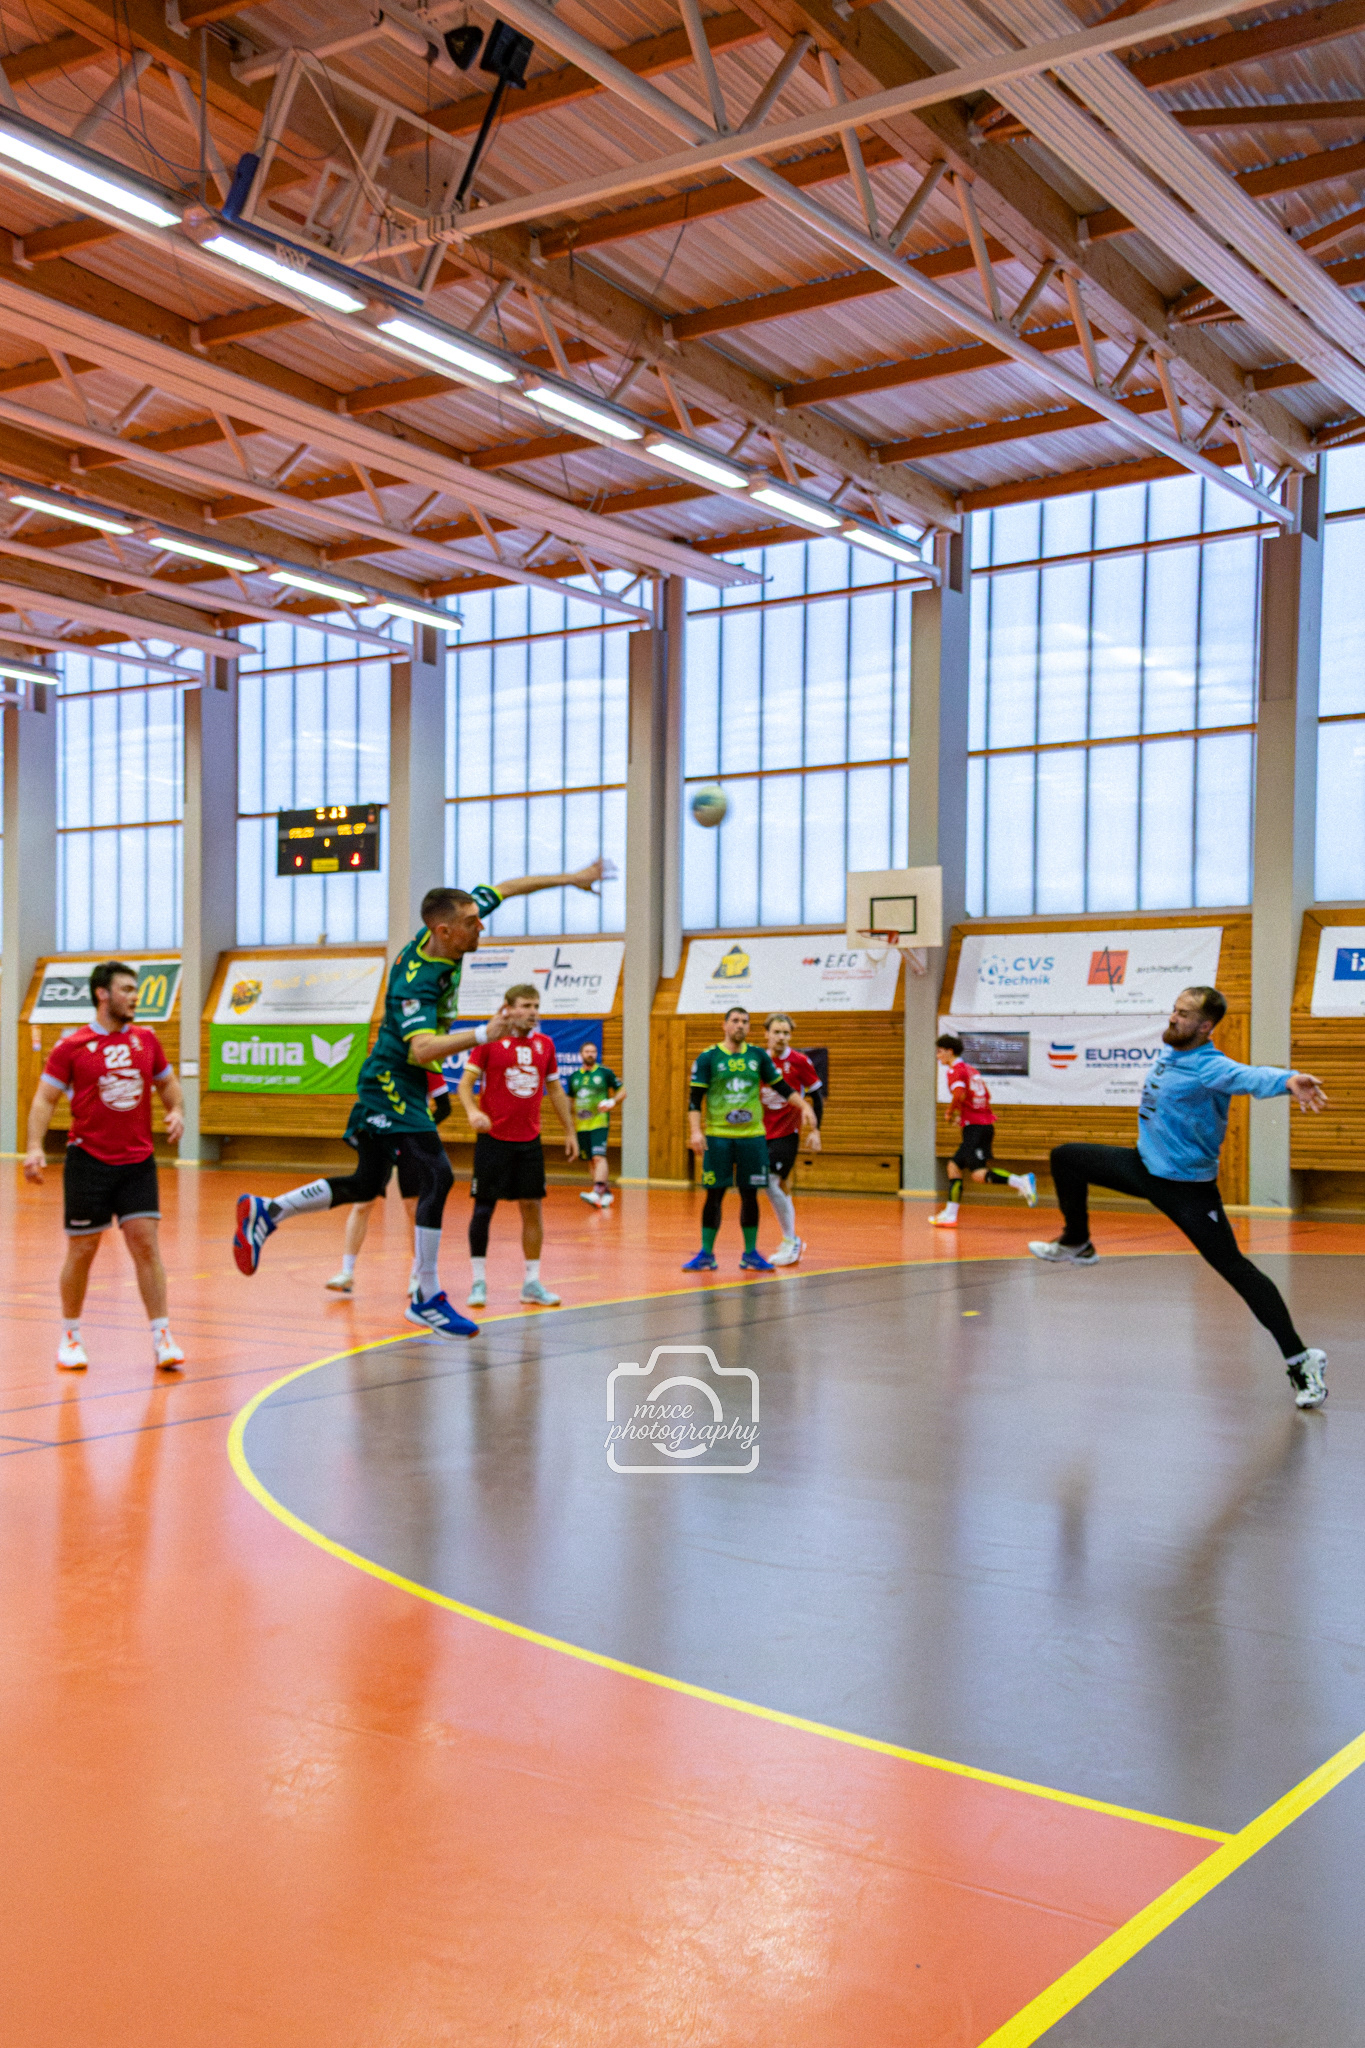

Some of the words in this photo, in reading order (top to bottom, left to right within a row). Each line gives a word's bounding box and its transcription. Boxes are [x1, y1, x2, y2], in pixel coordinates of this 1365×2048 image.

[1012, 956, 1055, 971] CVS
[998, 974, 1050, 986] Technik
[102, 1044, 132, 1069] 22
[221, 1035, 304, 1066] erima
[727, 1058, 746, 1072] 95
